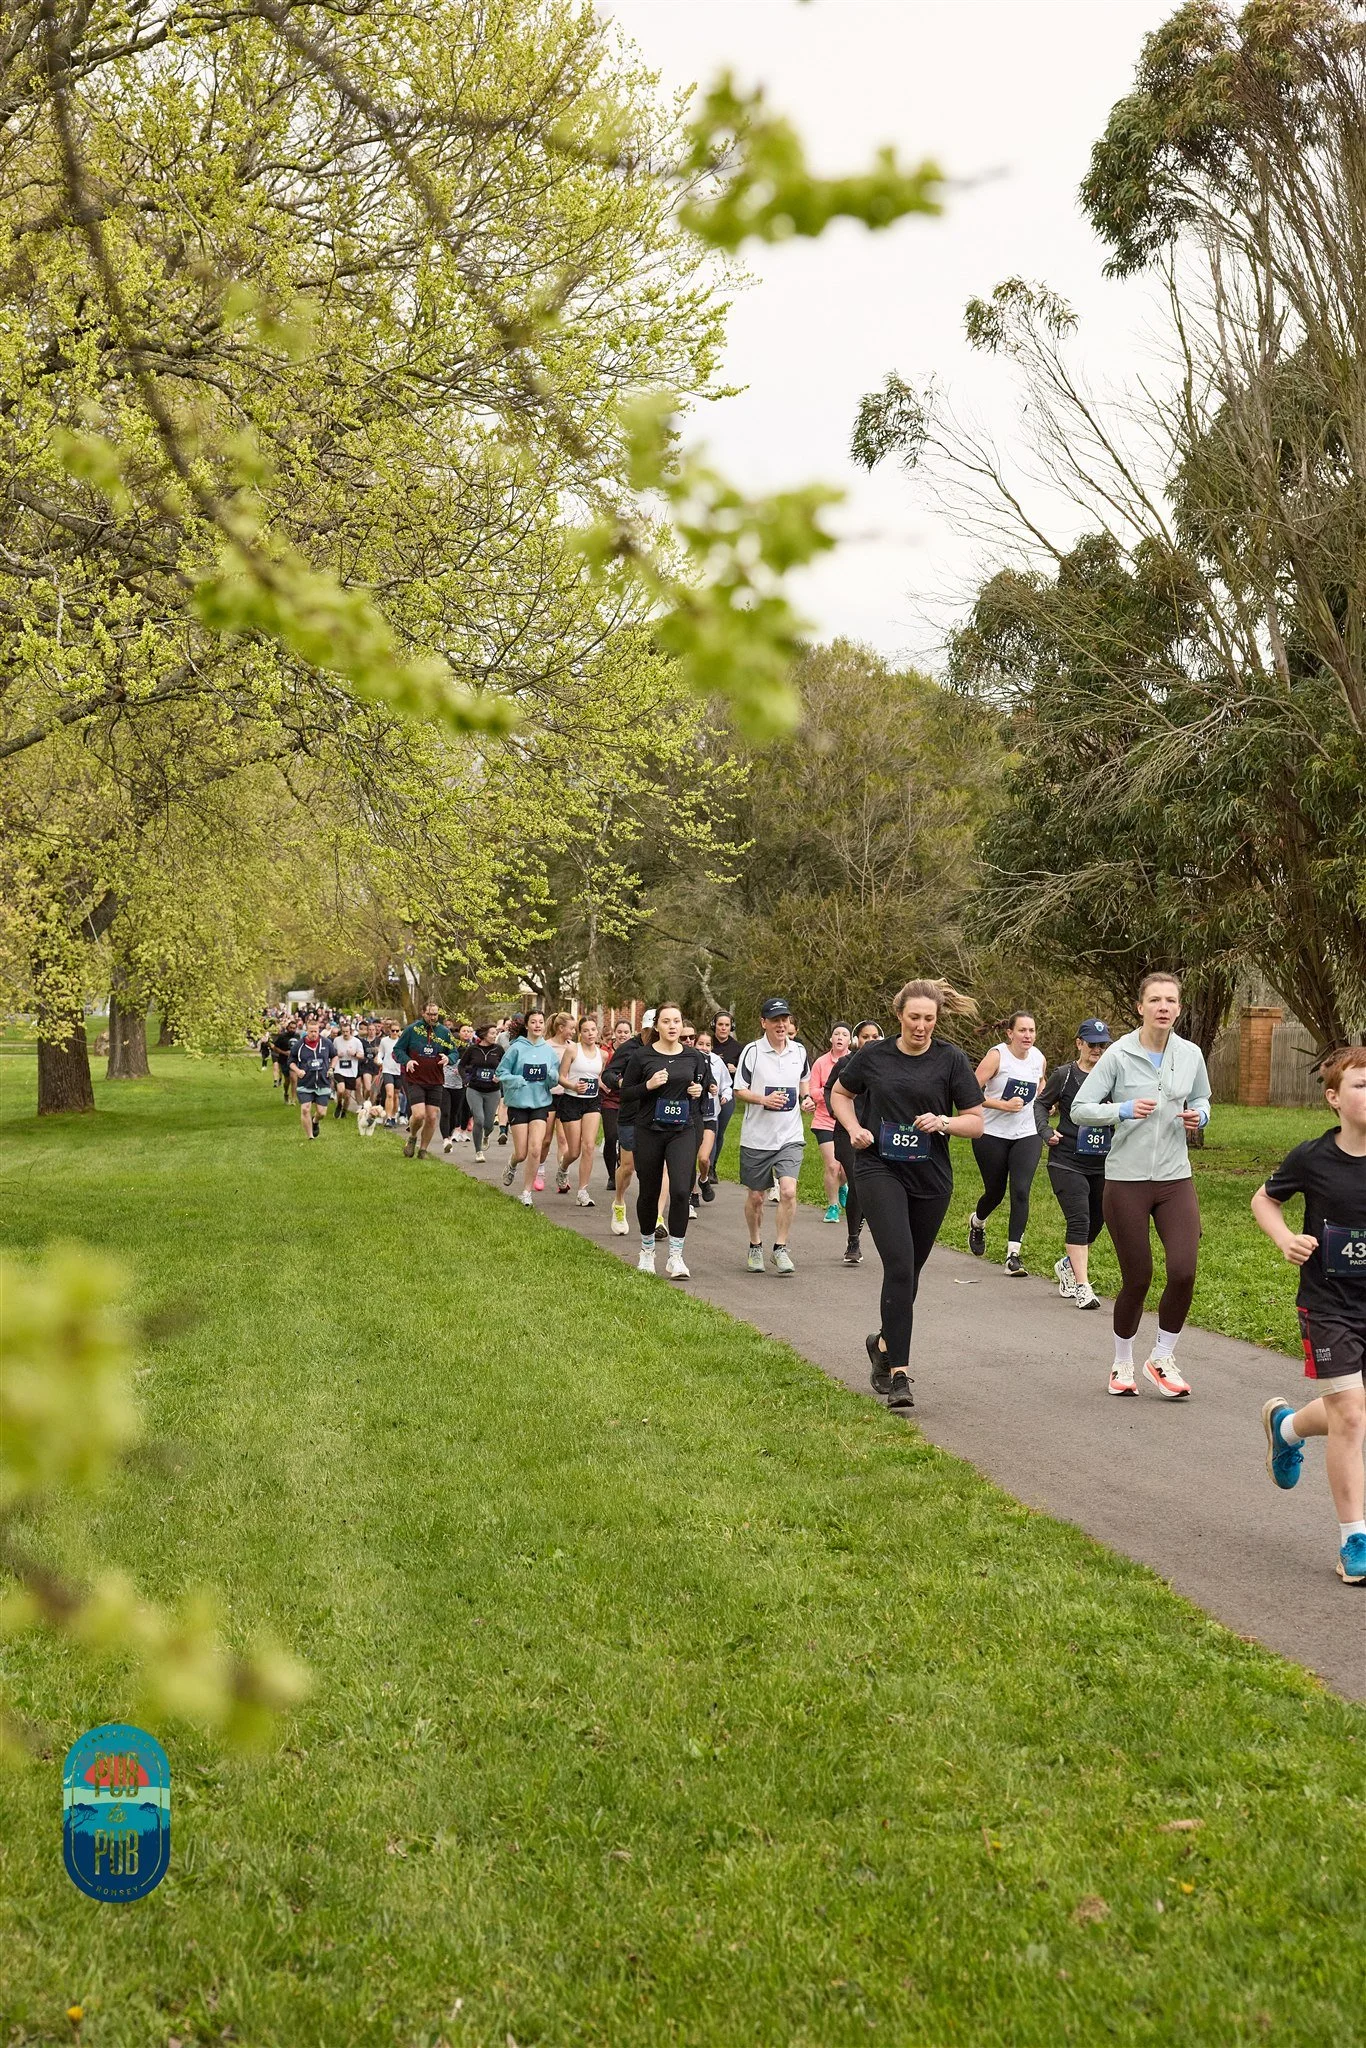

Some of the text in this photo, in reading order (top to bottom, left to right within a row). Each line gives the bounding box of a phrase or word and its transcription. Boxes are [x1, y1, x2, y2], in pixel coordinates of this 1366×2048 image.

[529, 1067, 541, 1075] 871
[1014, 1086, 1029, 1096] 783
[664, 1106, 681, 1115] 883
[892, 1134, 918, 1147] 852
[1087, 1134, 1105, 1145] 361
